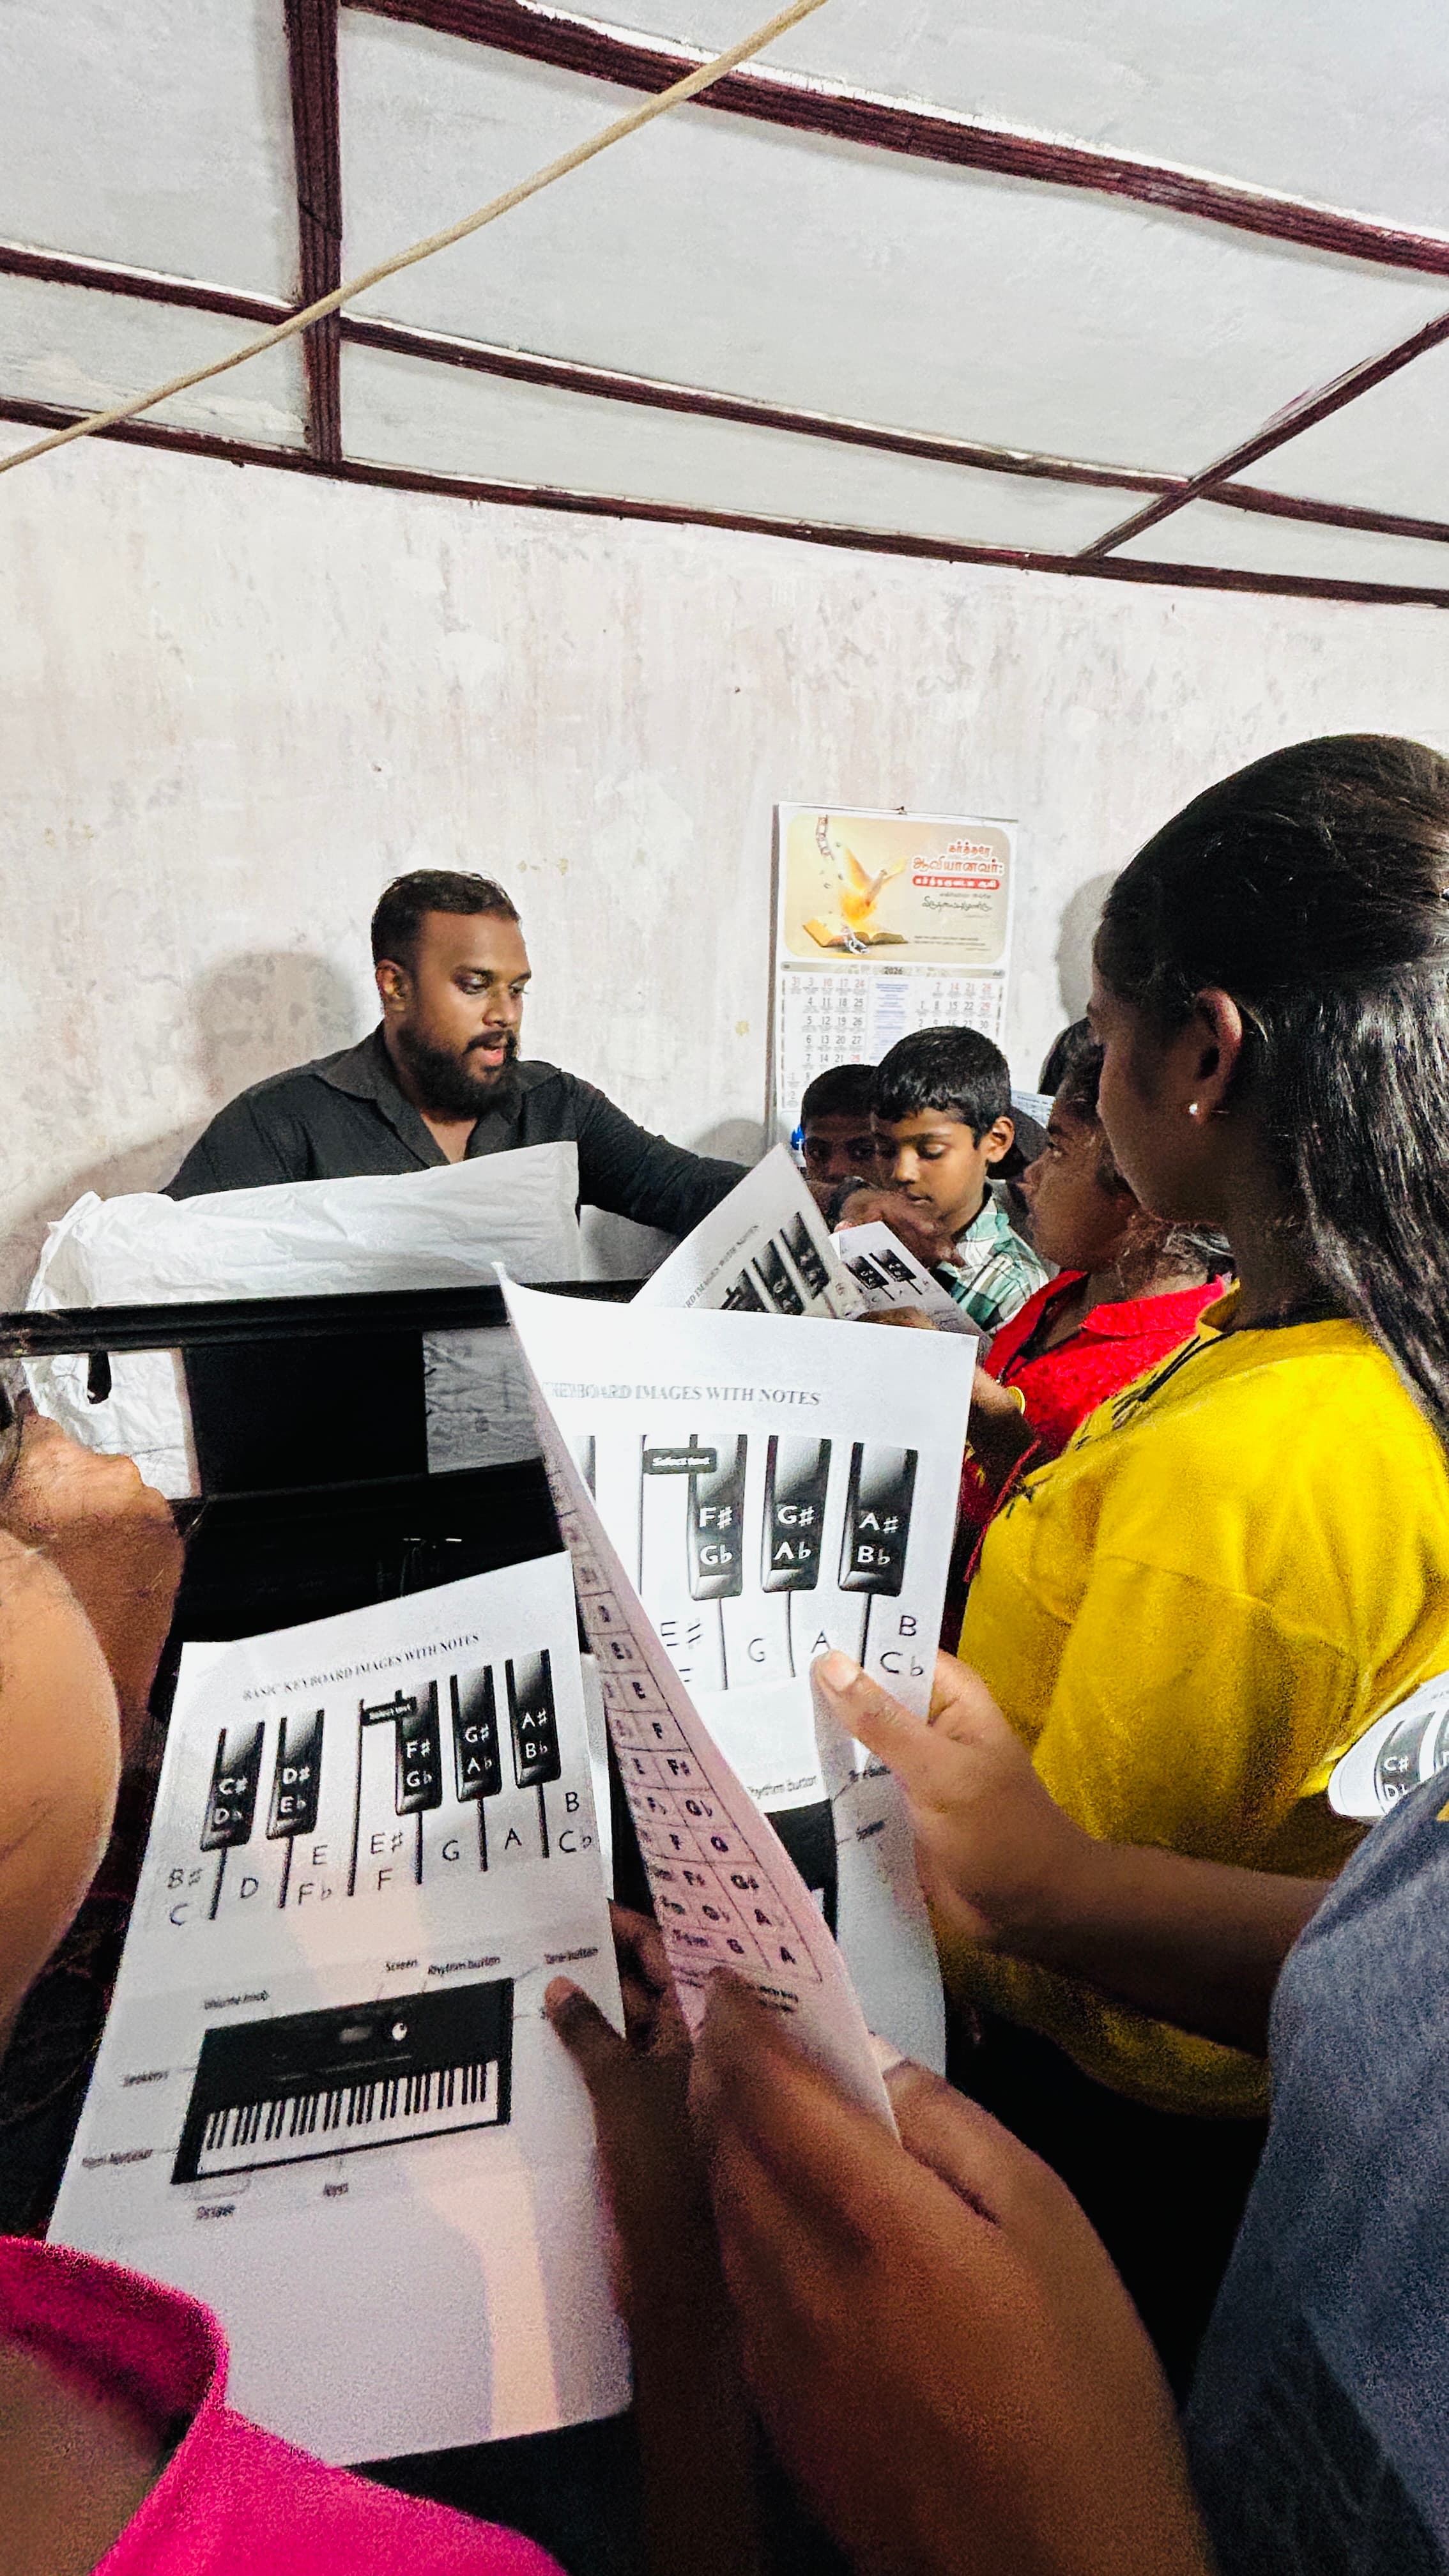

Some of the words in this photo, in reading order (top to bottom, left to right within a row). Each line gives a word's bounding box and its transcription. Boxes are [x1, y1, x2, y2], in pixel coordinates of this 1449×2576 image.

[854, 998, 864, 1008] 25
[965, 1001, 974, 1010] 22
[822, 1016, 831, 1025] 12
[836, 1035, 846, 1045] 20
[635, 1384, 702, 1400] IMAGES
[705, 1386, 753, 1402] WITH
[760, 1388, 822, 1406] NOTES
[747, 1638, 767, 1662] G
[812, 1630, 832, 1654] A
[899, 1615, 917, 1637] B
[355, 1654, 402, 1676] IMAGES
[404, 1643, 438, 1662] WITH
[440, 1634, 480, 1653] NOTES
[565, 1791, 580, 1813] B
[312, 1844, 328, 1866] E
[442, 1840, 460, 1862] G
[504, 1828, 523, 1850] A
[169, 1903, 193, 1926] C
[240, 1877, 259, 1899] D
[377, 1869, 394, 1891] F
